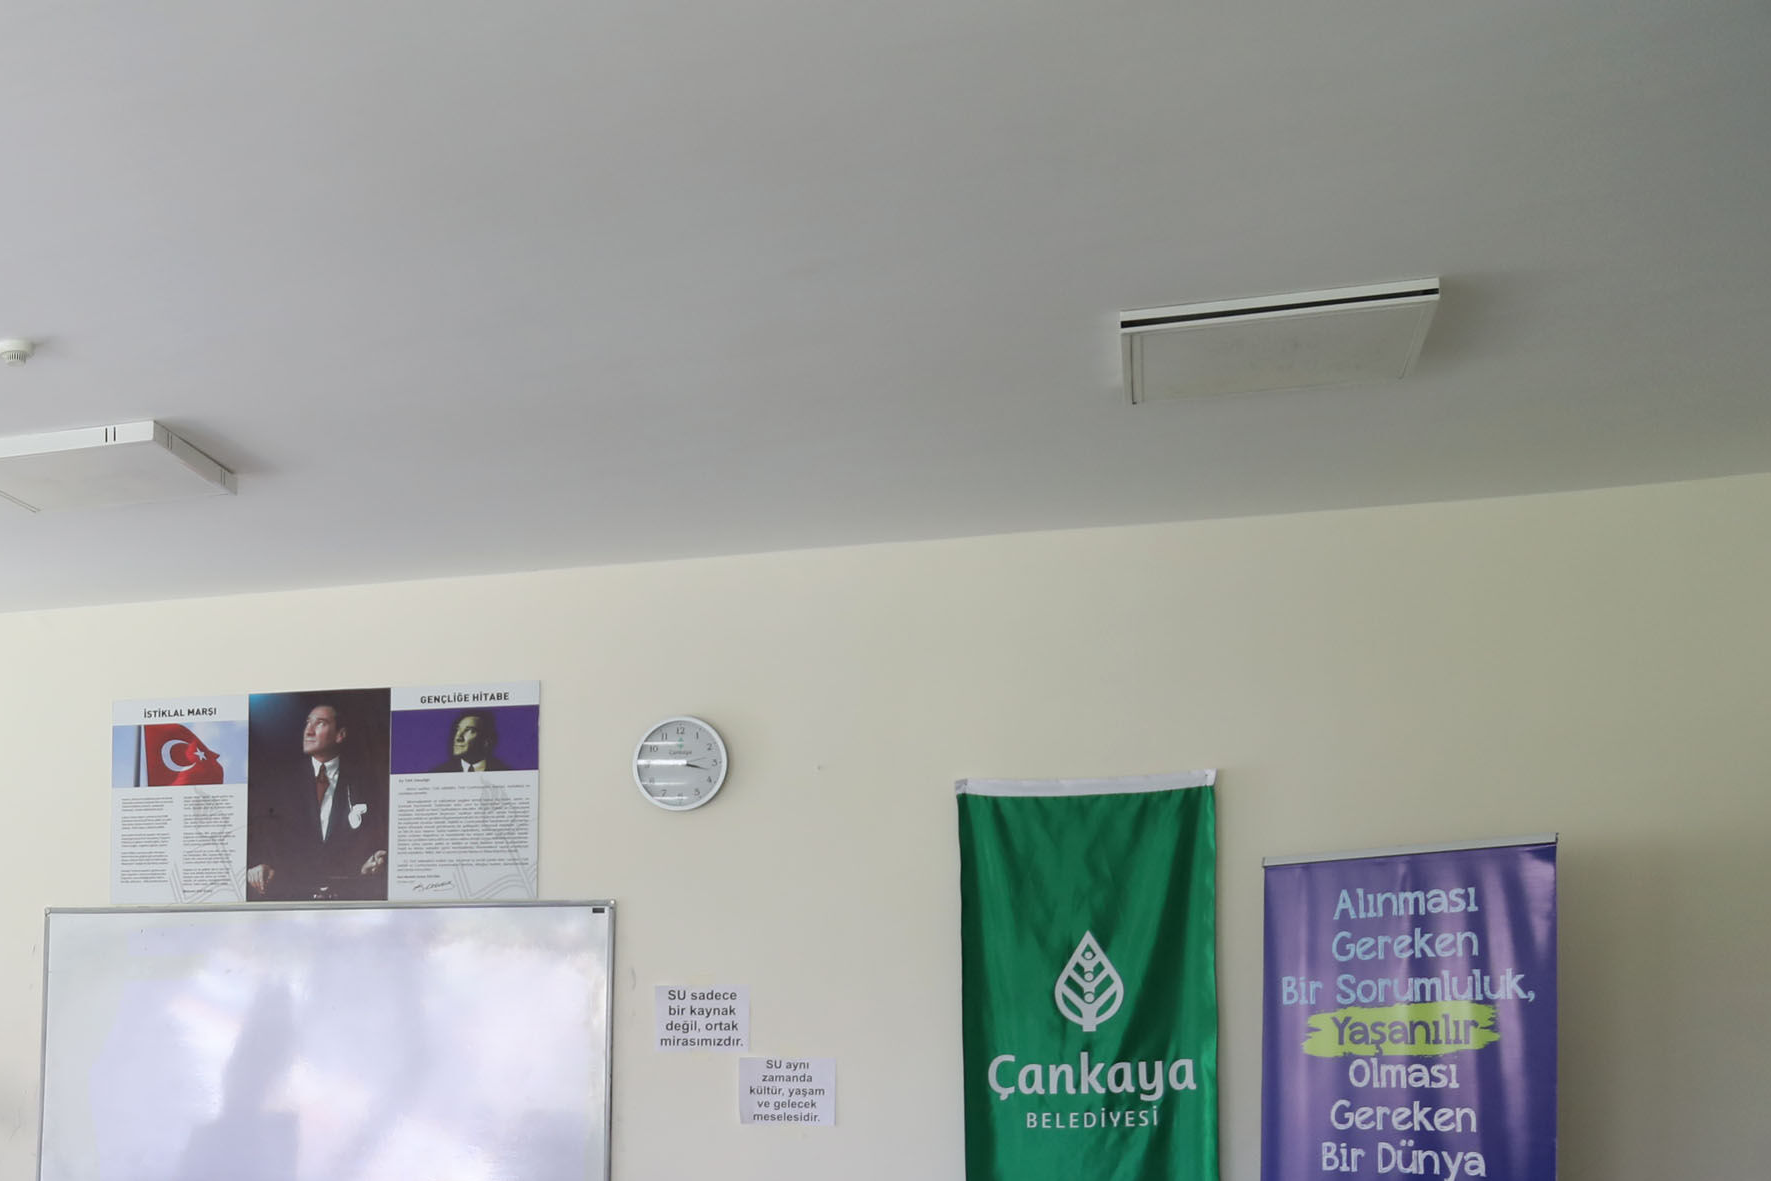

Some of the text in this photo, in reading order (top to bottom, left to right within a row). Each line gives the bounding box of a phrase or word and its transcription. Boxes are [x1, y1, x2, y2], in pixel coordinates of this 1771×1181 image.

[420, 691, 510, 705] GENÇLİĞE HİTABE
[143, 707, 218, 719] İSTİKLAL MARŞI
[661, 732, 668, 741] 11
[676, 726, 685, 735] 12
[695, 731, 699, 740] 1
[707, 743, 713, 751] 2
[712, 758, 718, 767] 3
[661, 789, 667, 797] 7
[694, 788, 700, 797] 5
[1333, 888, 1477, 919] Alınması
[1332, 929, 1478, 960] Gereken
[1283, 968, 1535, 1007] Bir Sorumluluk,
[668, 990, 737, 1000] SU sadece
[669, 1005, 735, 1018] bir kaynak
[665, 1020, 738, 1034] değil, ortak
[1333, 1015, 1478, 1046] Yaşanılır
[661, 1036, 742, 1046] mirasımızdır.
[767, 1060, 810, 1072] SU aynı
[762, 1073, 812, 1082] zamanda
[988, 1052, 1196, 1101] Çankaya
[1349, 1058, 1459, 1088] Olması
[750, 1086, 824, 1097] kültür, yaşam
[774, 1099, 816, 1110] gelecek
[752, 1111, 820, 1122] meselesidir.
[1027, 1106, 1157, 1128] BELEDİYESİ
[1331, 1100, 1476, 1132] Gereken
[1322, 1142, 1365, 1172] Bir
